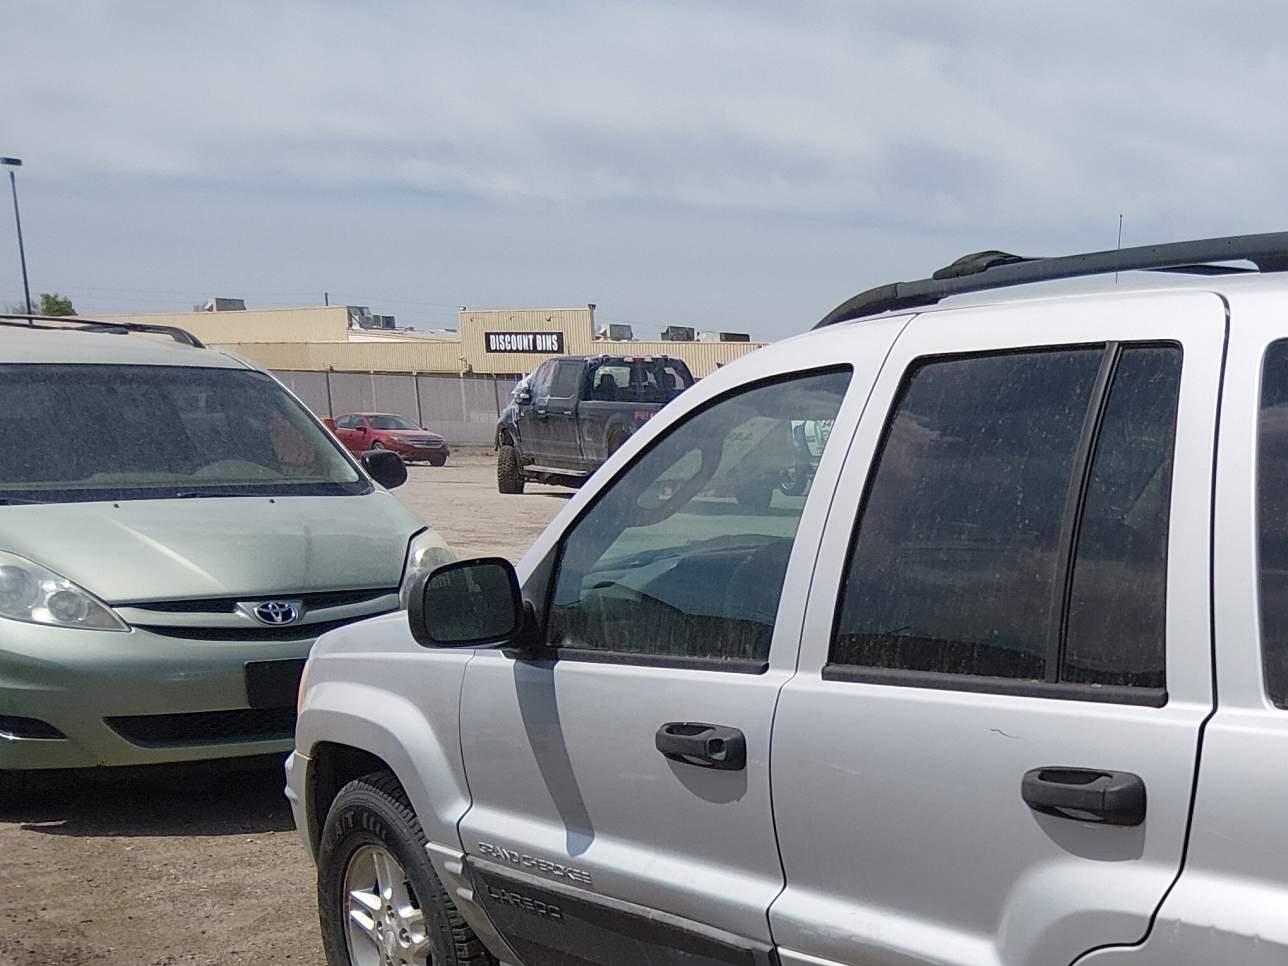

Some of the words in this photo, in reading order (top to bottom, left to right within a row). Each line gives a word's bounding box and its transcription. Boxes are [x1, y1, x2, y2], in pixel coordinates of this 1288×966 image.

[489, 334, 534, 350] DISCOUNT
[536, 334, 558, 351] BINS
[479, 841, 520, 863] GRAND
[521, 854, 592, 884] CHEROKEE
[486, 885, 563, 918] LAREDO
